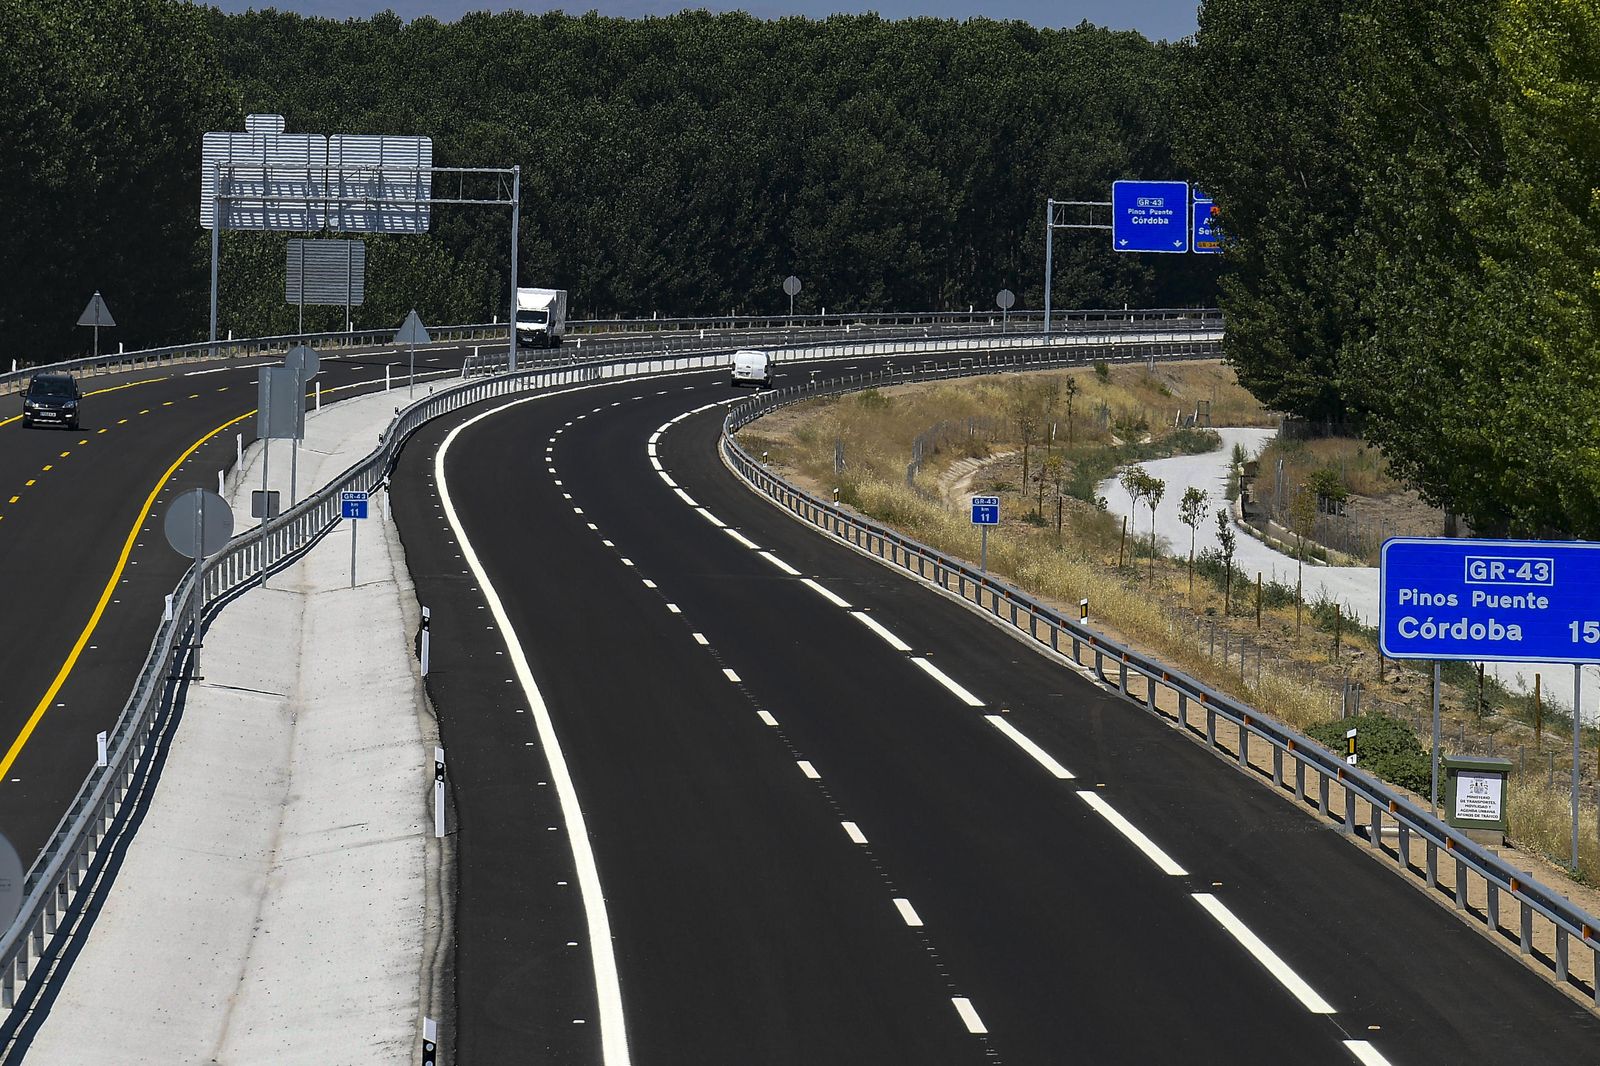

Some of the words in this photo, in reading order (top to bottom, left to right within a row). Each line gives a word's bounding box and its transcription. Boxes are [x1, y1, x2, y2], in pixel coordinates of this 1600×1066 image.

[1132, 216, 1169, 224] Córdoba
[350, 508, 359, 516] 11
[981, 513, 990, 522] 11
[1469, 561, 1549, 582] GR-43
[1399, 588, 1459, 607] Pinos
[1472, 590, 1549, 610] Puente
[1398, 615, 1523, 641] Córdoba
[1568, 620, 1600, 644] 15
